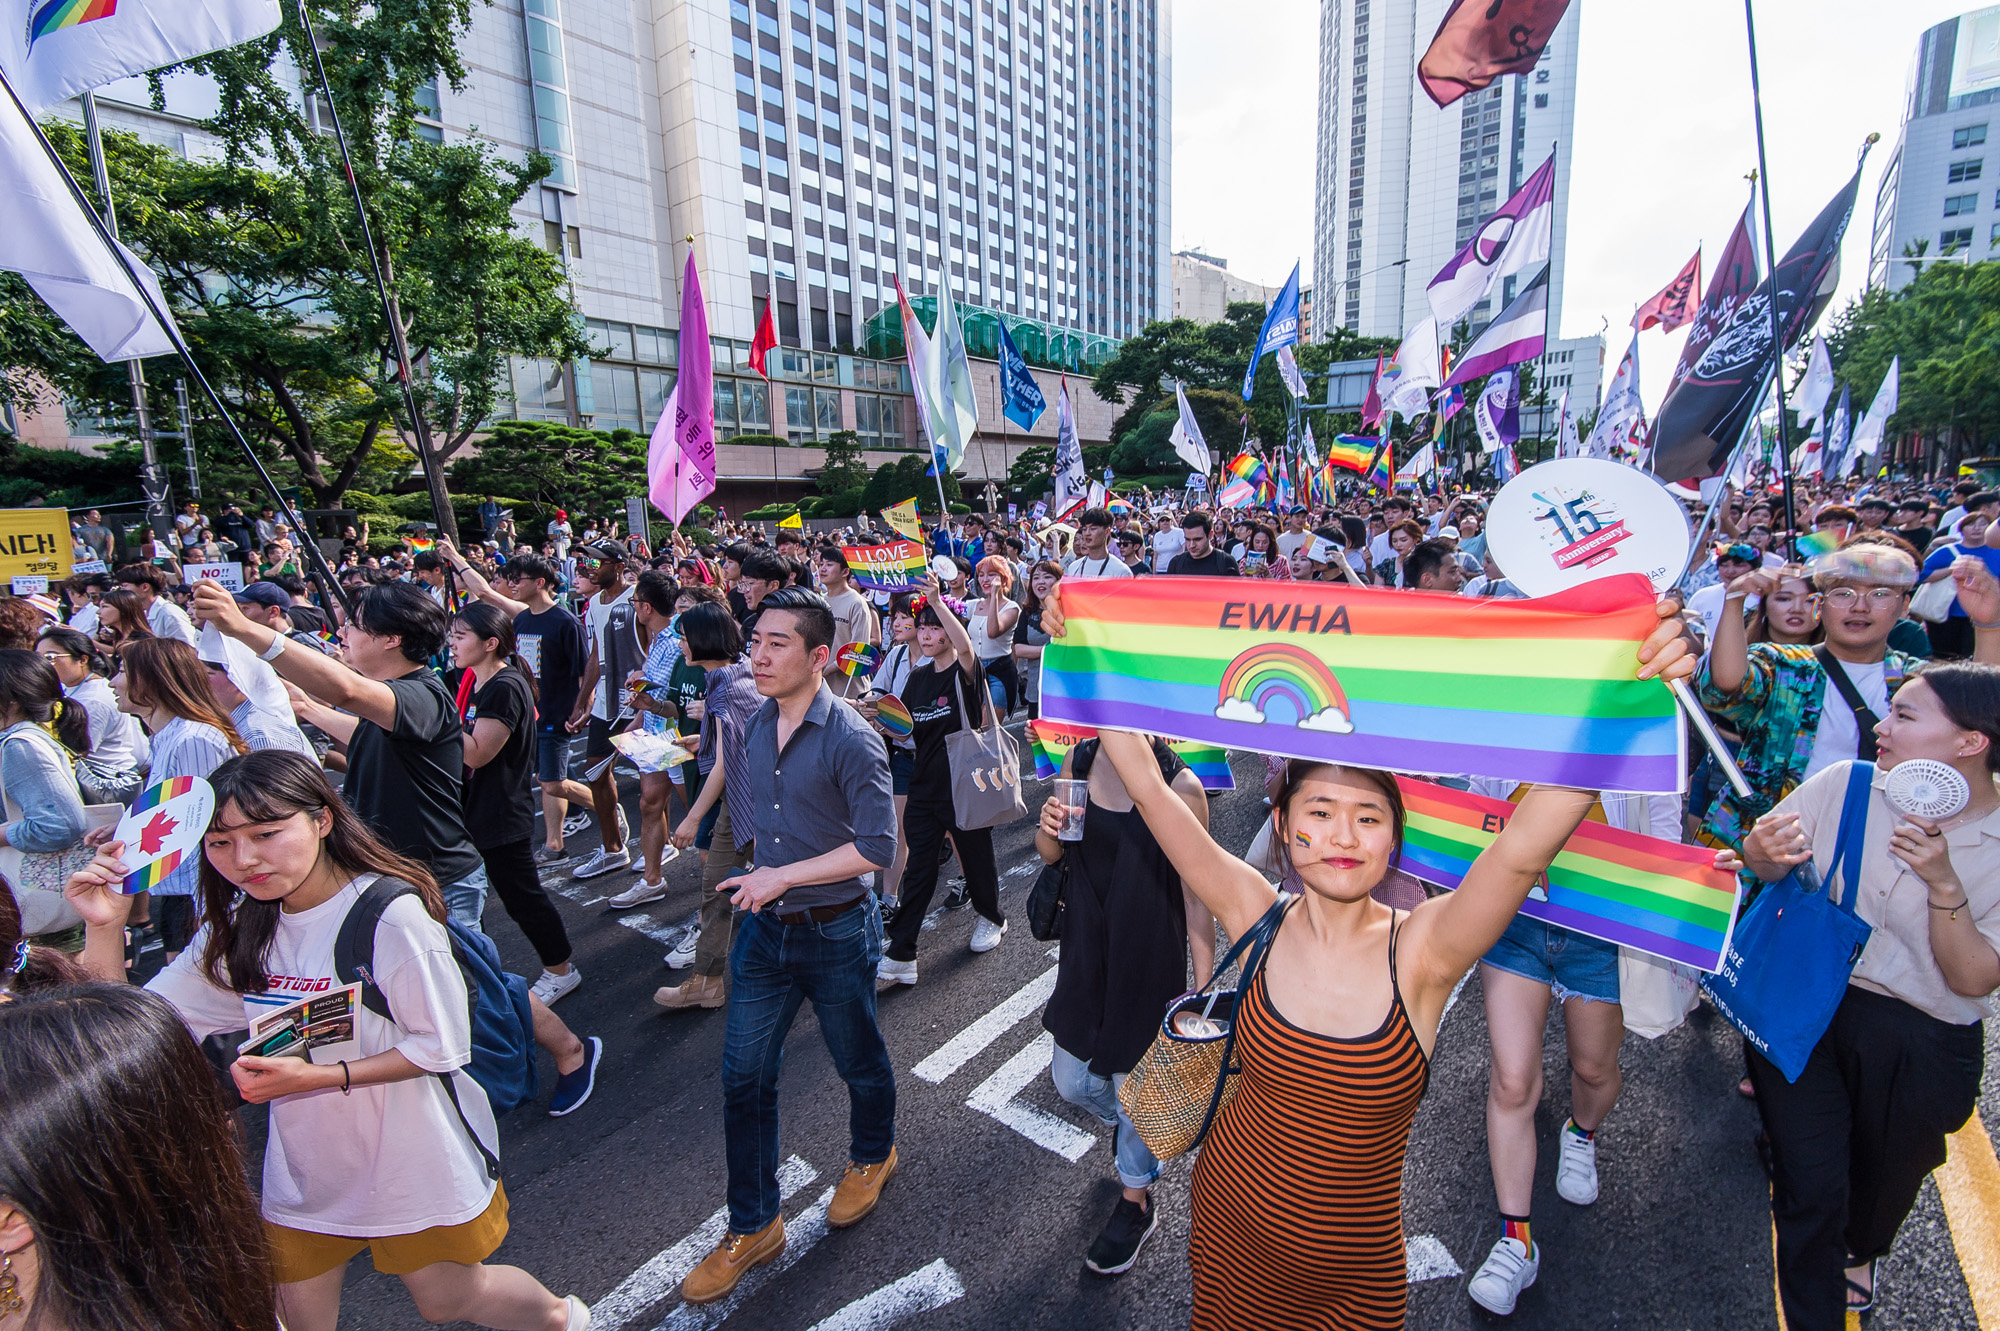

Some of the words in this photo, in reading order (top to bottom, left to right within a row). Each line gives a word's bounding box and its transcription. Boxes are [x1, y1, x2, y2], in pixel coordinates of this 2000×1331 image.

[1583, 493, 1595, 502] th
[1557, 525, 1624, 564] Anniversary
[855, 549, 863, 562] I
[865, 543, 911, 563] LOVE
[25, 562, 58, 573] 정의당
[865, 560, 906, 575] WHO
[871, 573, 878, 585] I
[883, 573, 908, 586] AM
[1218, 602, 1352, 636] EWHA
[1054, 733, 1086, 747] 201
[314, 996, 344, 1009] PROUD
[1736, 1017, 1769, 1053] TODAY
